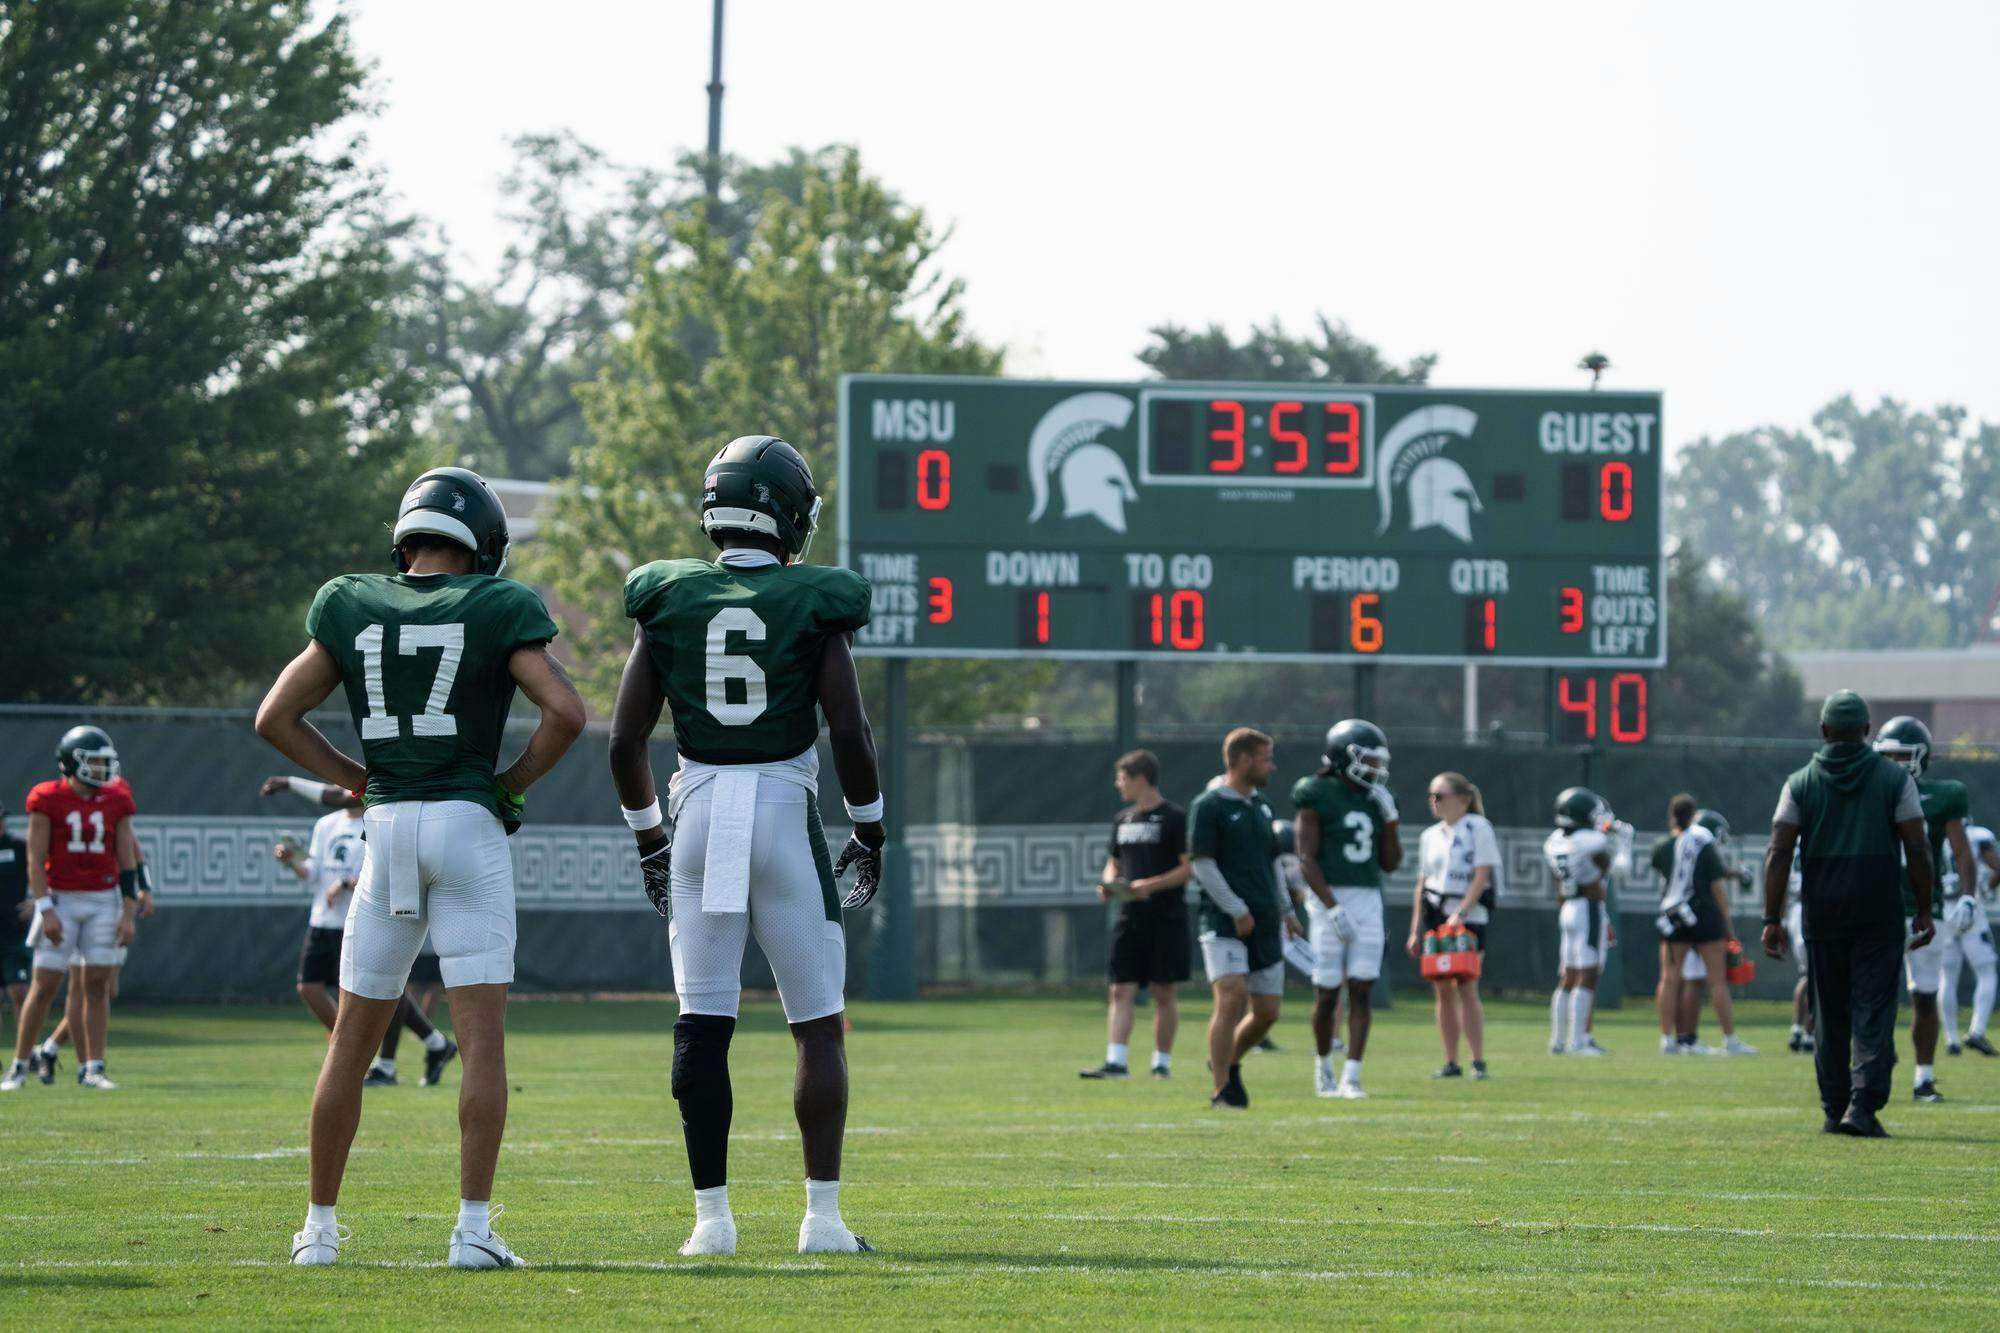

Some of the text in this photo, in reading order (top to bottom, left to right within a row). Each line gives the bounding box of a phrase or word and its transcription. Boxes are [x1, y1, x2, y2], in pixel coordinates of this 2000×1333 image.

[871, 398, 955, 442] MSU
[1209, 399, 1361, 474] 3:53
[1537, 410, 1657, 455] GUEST
[916, 449, 951, 511] 0
[1599, 461, 1634, 522] 0
[859, 553, 919, 582] TIME
[985, 551, 1080, 586] DOWN
[1124, 553, 1214, 589] TO GO
[1292, 556, 1400, 592] PERIOD
[1449, 558, 1509, 594] QTR
[1592, 565, 1650, 595] TIME
[871, 584, 919, 614] UTS
[928, 576, 953, 624] 3
[1036, 591, 1050, 645] 1
[1150, 589, 1205, 651] 10
[1350, 593, 1384, 653] 6
[1561, 586, 1584, 634] 3
[1591, 594, 1657, 627] OUTS
[1483, 599, 1497, 650] 1
[1591, 626, 1650, 655] LEFT
[354, 622, 465, 740] 17
[705, 607, 768, 726] 6
[1558, 673, 1648, 744] 40
[65, 810, 106, 854] 11
[1343, 810, 1375, 863] 3
